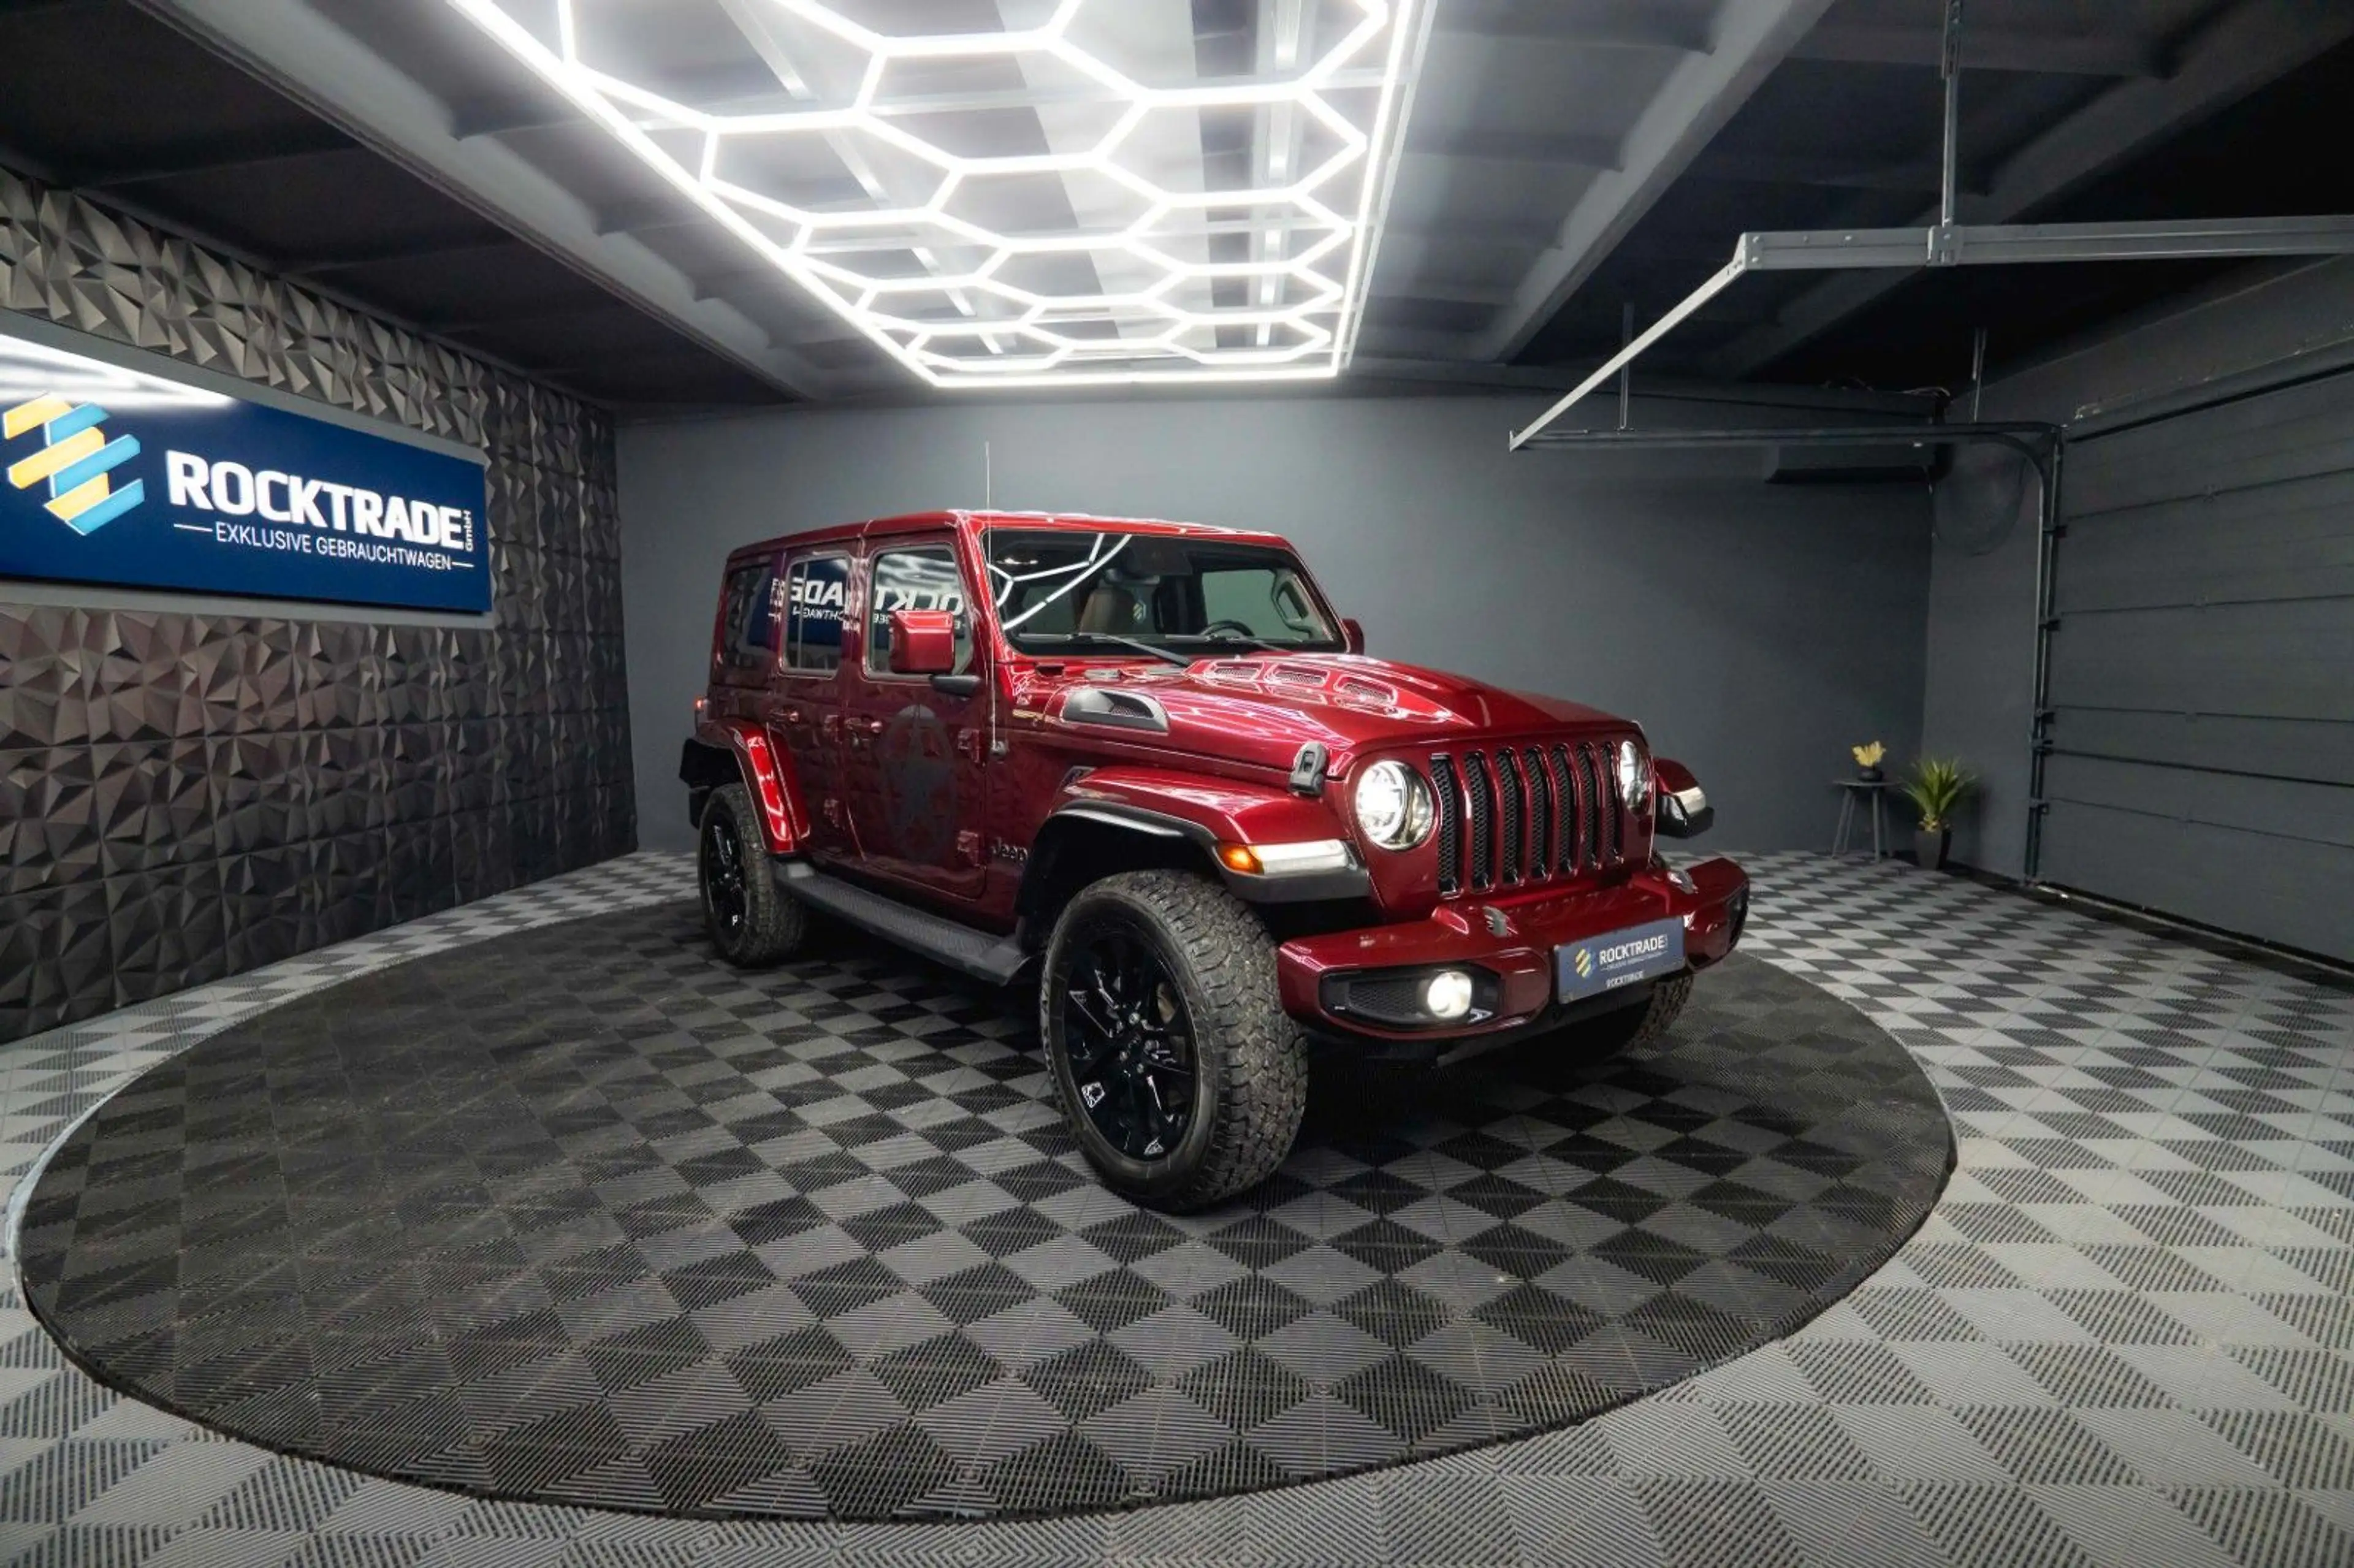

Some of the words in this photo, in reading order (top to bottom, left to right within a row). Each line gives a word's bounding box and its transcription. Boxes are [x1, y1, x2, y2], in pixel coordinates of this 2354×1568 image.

[165, 449, 465, 550] ROCKTRADE
[216, 521, 311, 553] EXKLUSIVE
[316, 536, 452, 570] GEBRAUCHTWAGEN
[463, 509, 474, 552] GmbH
[991, 836, 1029, 862] Jeep
[1599, 935, 1666, 965] ROCKTRADE
